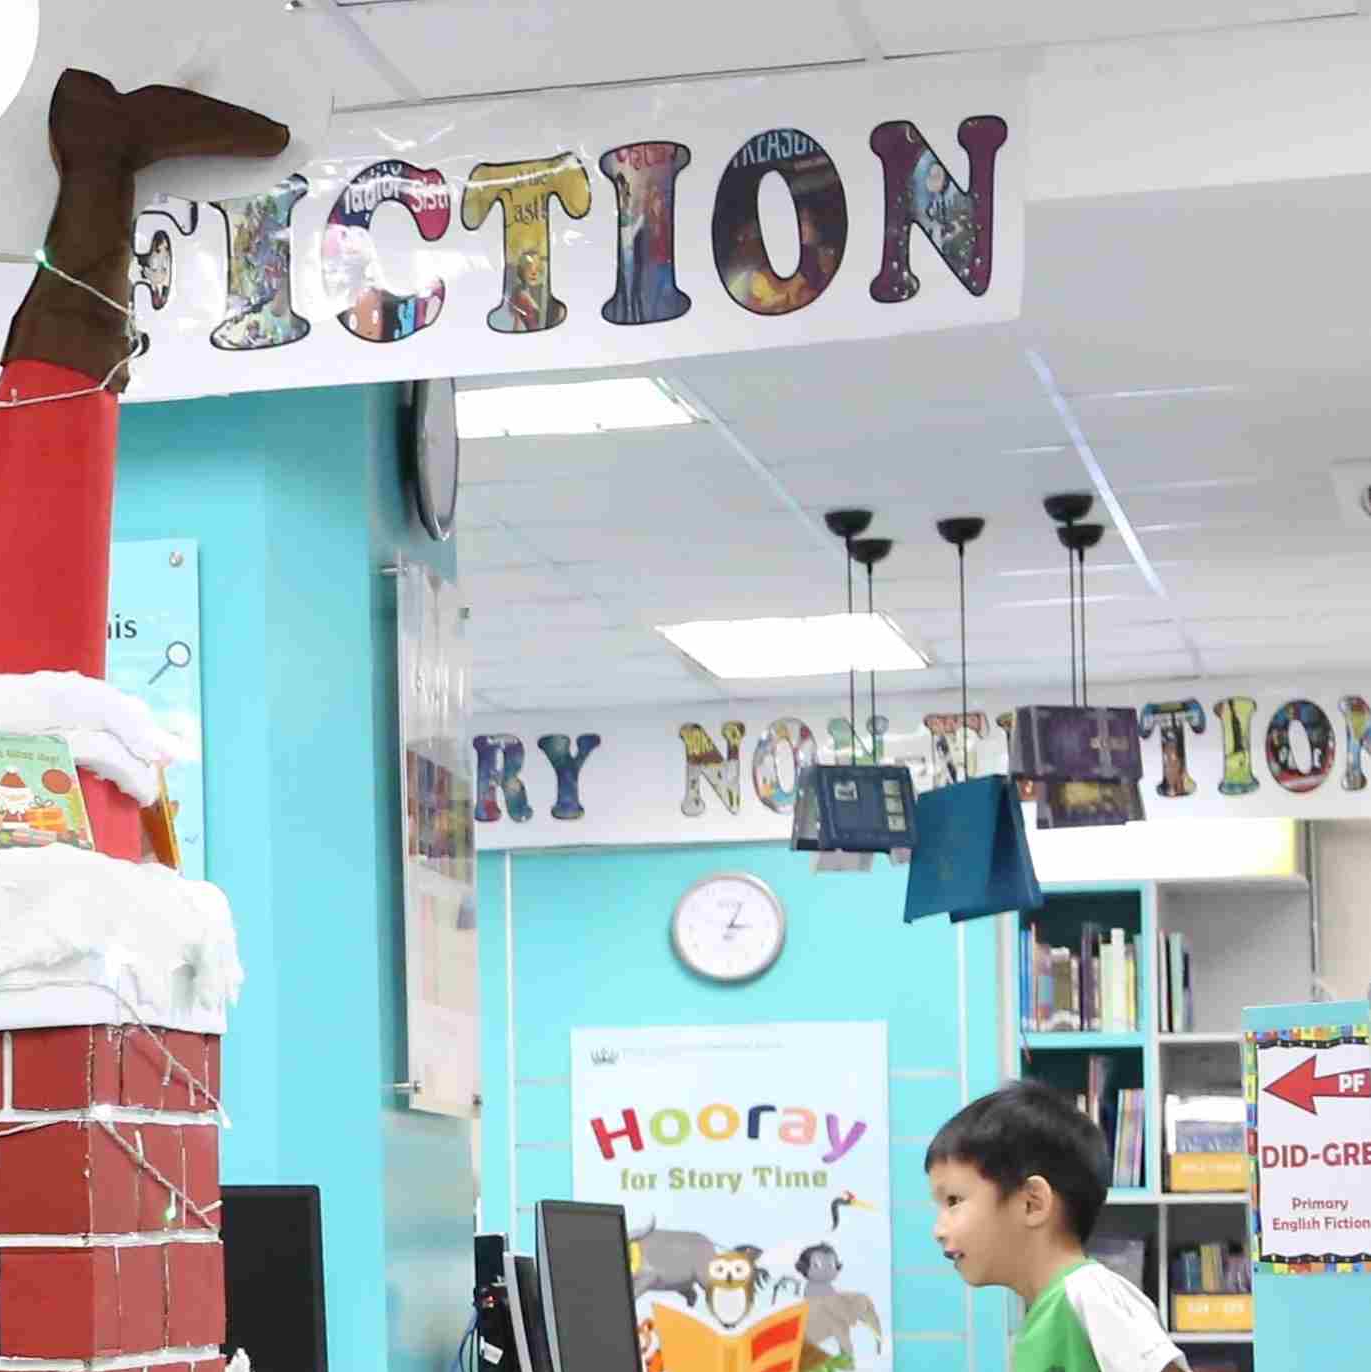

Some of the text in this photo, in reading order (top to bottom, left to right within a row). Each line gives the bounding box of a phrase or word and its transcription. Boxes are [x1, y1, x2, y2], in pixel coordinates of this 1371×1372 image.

[106, 614, 138, 640] is
[1339, 1072, 1366, 1094] PF
[590, 1102, 868, 1164] Hooray
[620, 1166, 829, 1194] for Story Time
[1291, 1196, 1349, 1211] Primary
[1272, 1215, 1371, 1232] English Fiction
